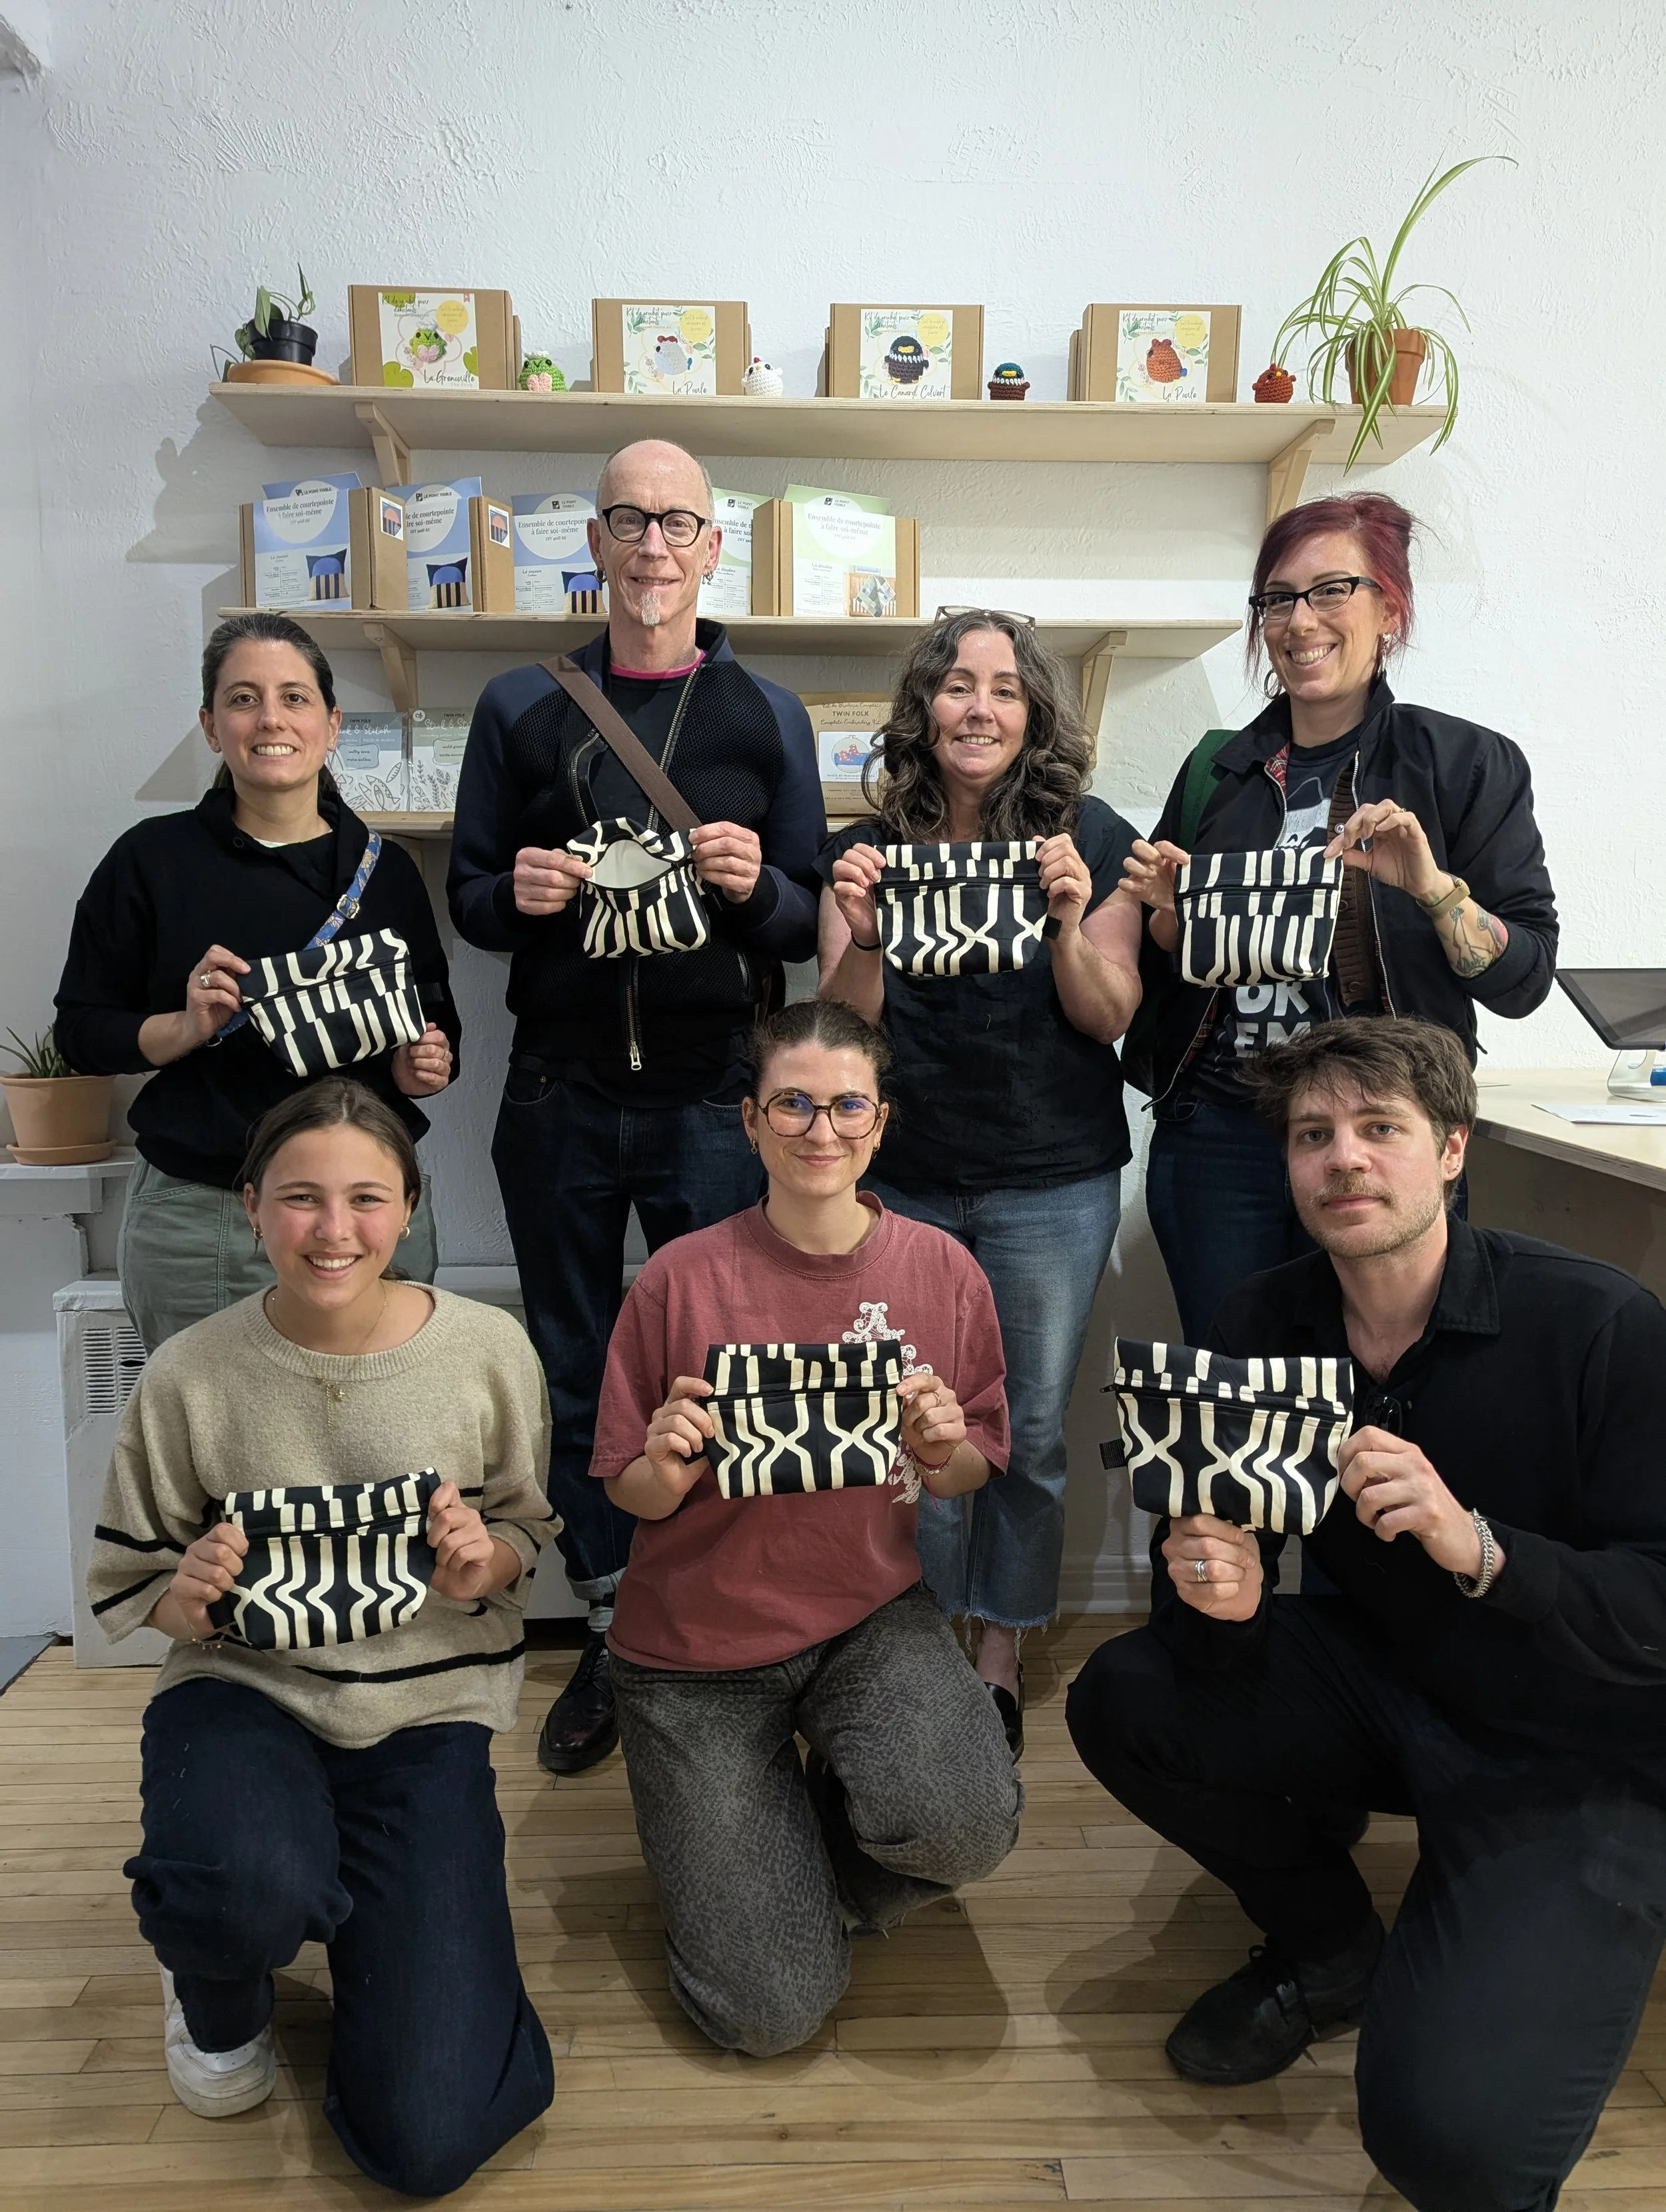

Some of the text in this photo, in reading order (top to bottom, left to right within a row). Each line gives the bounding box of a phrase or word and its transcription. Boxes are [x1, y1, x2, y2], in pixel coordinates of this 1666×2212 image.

[661, 310, 672, 319] pour
[1157, 316, 1168, 325] pour
[424, 369, 475, 385] La Grenouille
[672, 381, 707, 395] La Poule
[880, 384, 950, 398] Le Canard Colvert
[1163, 386, 1197, 400] La Poule
[267, 504, 291, 512] Ensemble
[300, 498, 334, 508] courtepointe
[419, 508, 454, 518] courtepointe
[415, 518, 442, 526] soi-même
[555, 518, 588, 526] courtepoin
[808, 513, 836, 523] Ensemble
[845, 520, 881, 530] courtepointe
[826, 523, 839, 532] faire
[840, 526, 868, 535] soi-même
[339, 724, 391, 736] ick & Stitch
[424, 719, 446, 730] Stick
[449, 720, 454, 730] &
